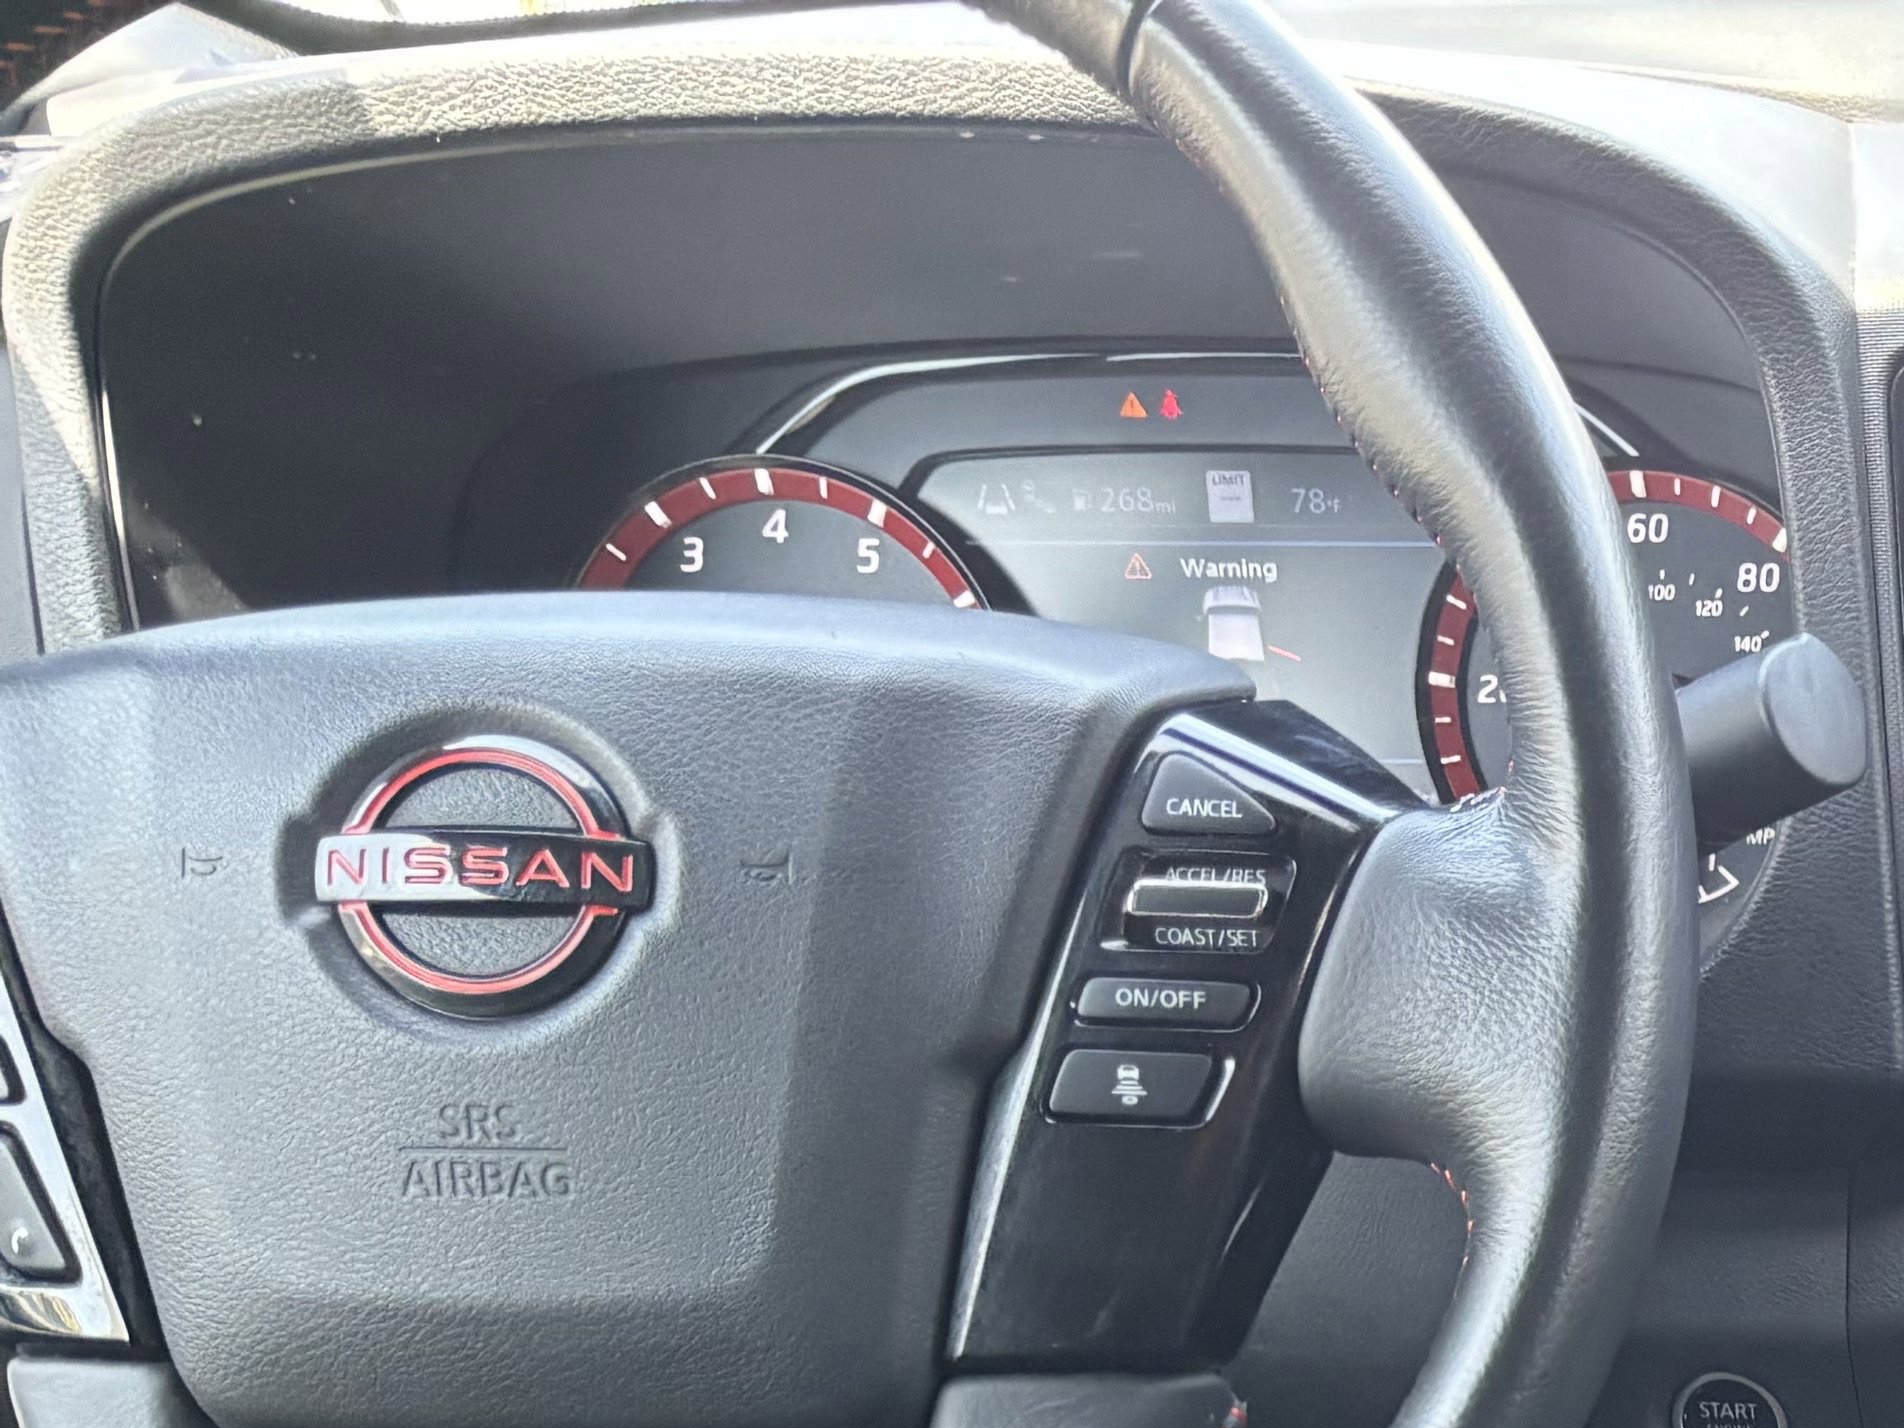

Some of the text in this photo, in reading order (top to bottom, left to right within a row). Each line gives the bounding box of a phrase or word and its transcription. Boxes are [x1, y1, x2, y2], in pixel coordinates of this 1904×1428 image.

[762, 509, 789, 544] 4
[1627, 514, 1669, 543] 60
[680, 538, 704, 573] 3
[856, 538, 880, 574] 5
[1180, 558, 1278, 583] Warning
[1736, 562, 1780, 593] 80
[1648, 584, 1675, 601] 100
[1695, 599, 1723, 617] 120
[1734, 635, 1762, 652] 140
[1477, 676, 1505, 703] 2
[1166, 798, 1242, 819] CANCEL
[1746, 826, 1775, 844] MP
[328, 848, 634, 892] NISSAN
[1155, 928, 1259, 947] COAST/SET
[1116, 988, 1206, 1010] ON/OFF
[437, 1104, 521, 1141] SRS
[401, 1160, 573, 1198] AIRBAG
[1699, 1401, 1757, 1421] START
